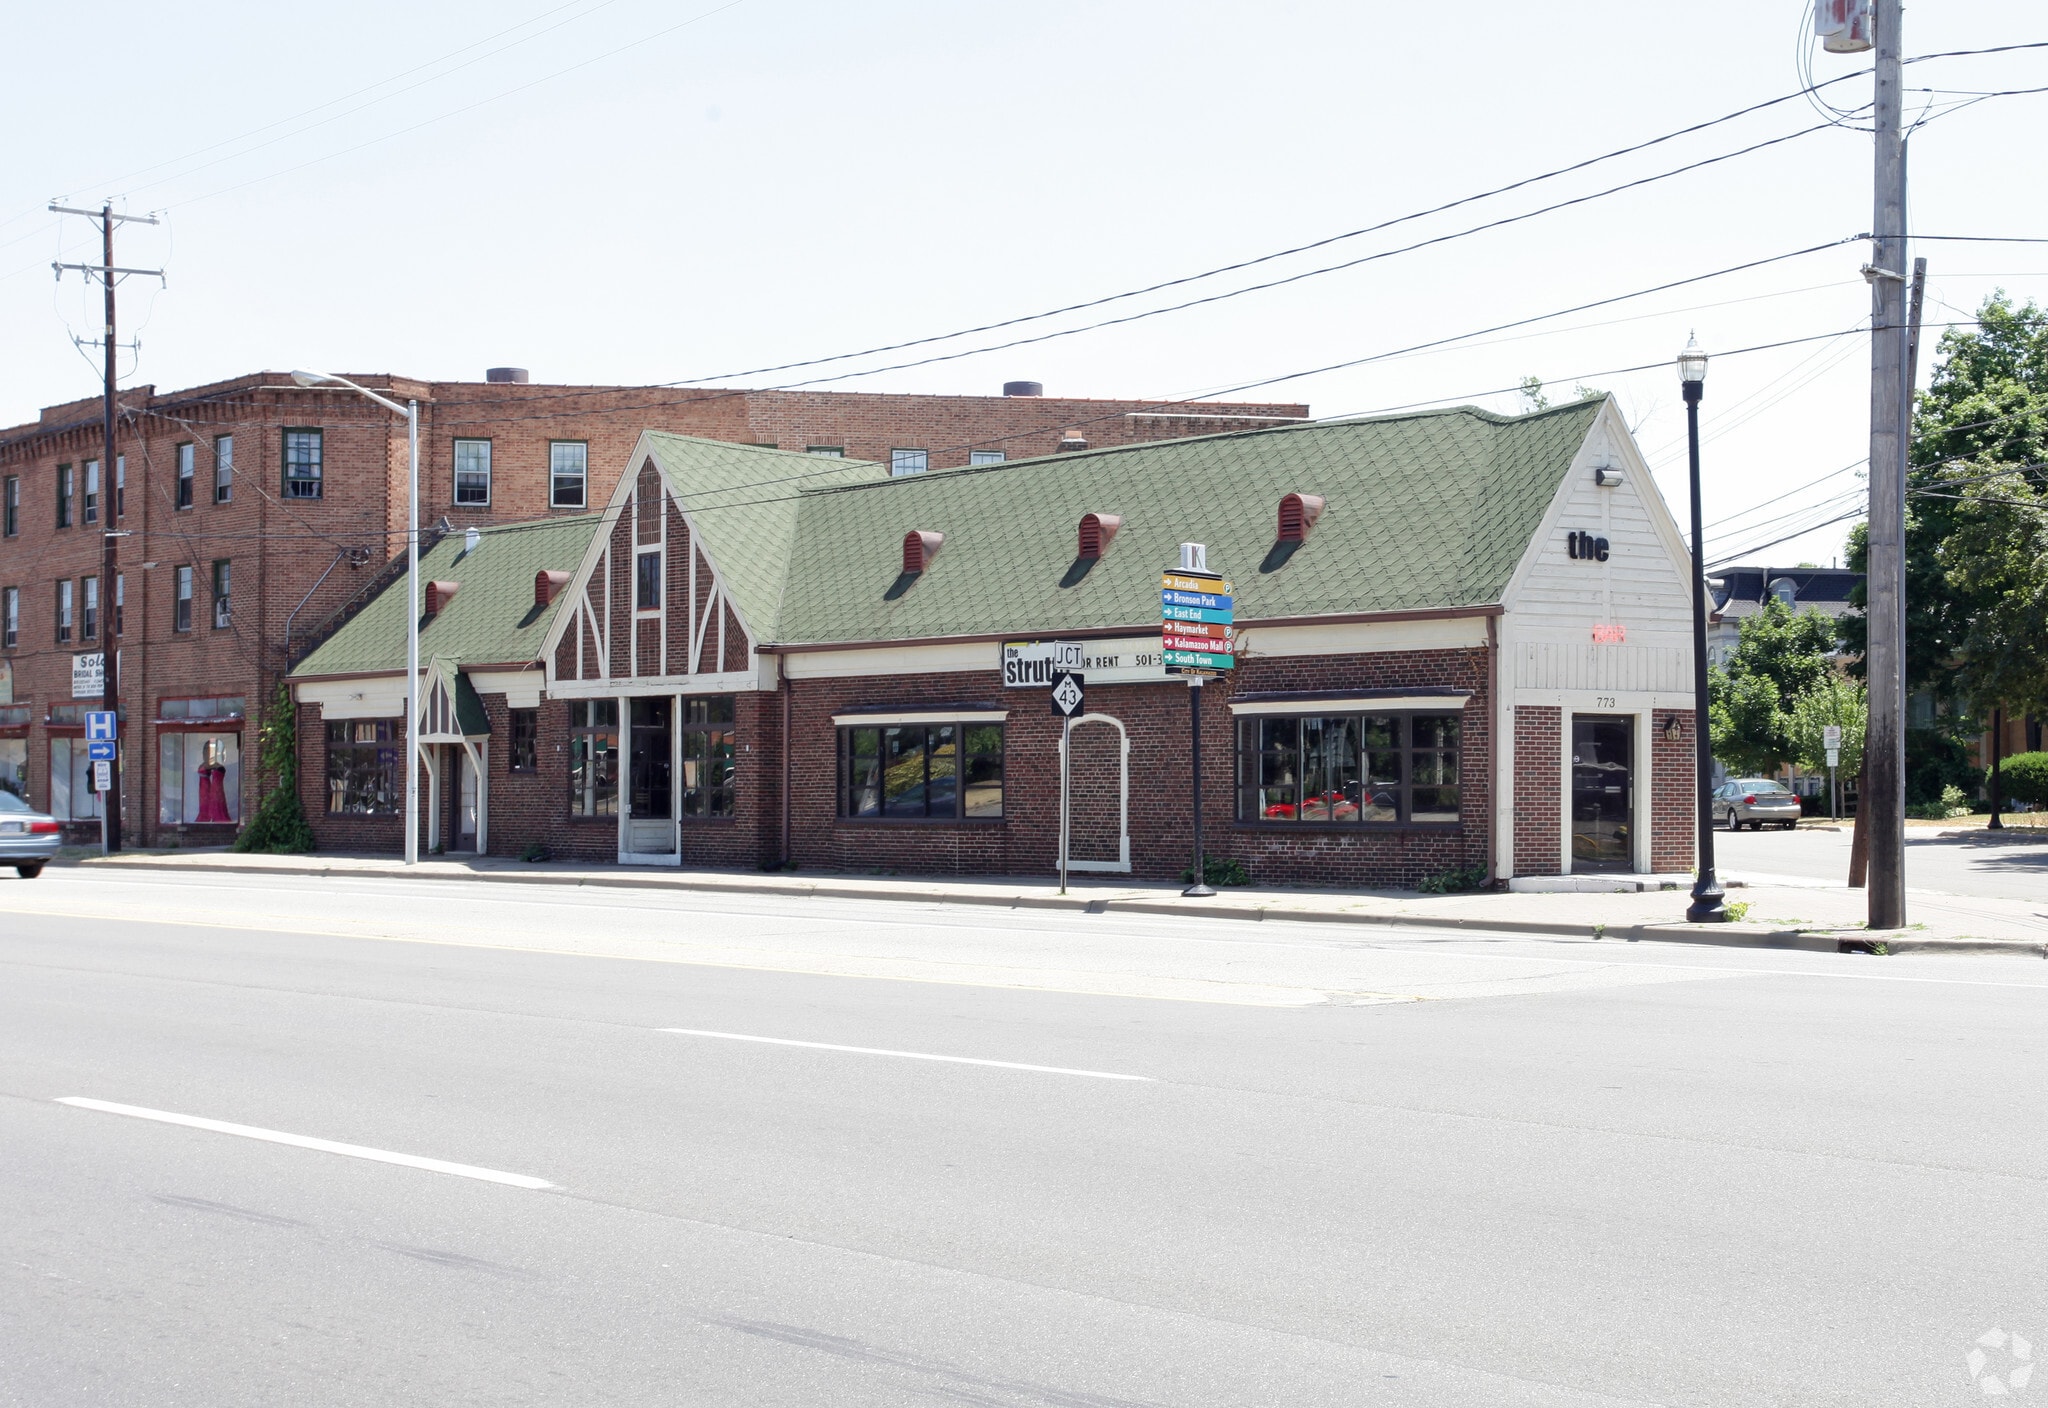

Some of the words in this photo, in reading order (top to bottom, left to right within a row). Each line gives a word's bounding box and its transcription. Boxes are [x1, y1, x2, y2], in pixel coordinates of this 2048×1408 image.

[1568, 531, 1609, 562] the
[1174, 578, 1198, 590] Arcadia
[1174, 592, 1200, 605] Bronson
[1202, 595, 1216, 607] Park
[1174, 607, 1189, 619] East
[1190, 609, 1202, 620] End
[1174, 622, 1209, 635] Haymarket
[1593, 624, 1626, 643] BAR
[1174, 637, 1208, 650] Kalamazoo
[1210, 640, 1223, 651] Mall
[1007, 648, 1019, 659] the
[1057, 647, 1080, 665] JCT
[1175, 652, 1195, 664] South
[1195, 654, 1212, 665] Town
[1081, 656, 1092, 668] OR
[1096, 656, 1119, 668] RENT
[1136, 654, 1163, 666] 501-3
[74, 669, 93, 679] BRIDAL
[95, 668, 105, 678] SH
[1006, 656, 1056, 684] strut
[1064, 681, 1071, 689] M
[1059, 689, 1077, 706] 43
[1597, 697, 1616, 708] 773
[90, 714, 112, 739] H
